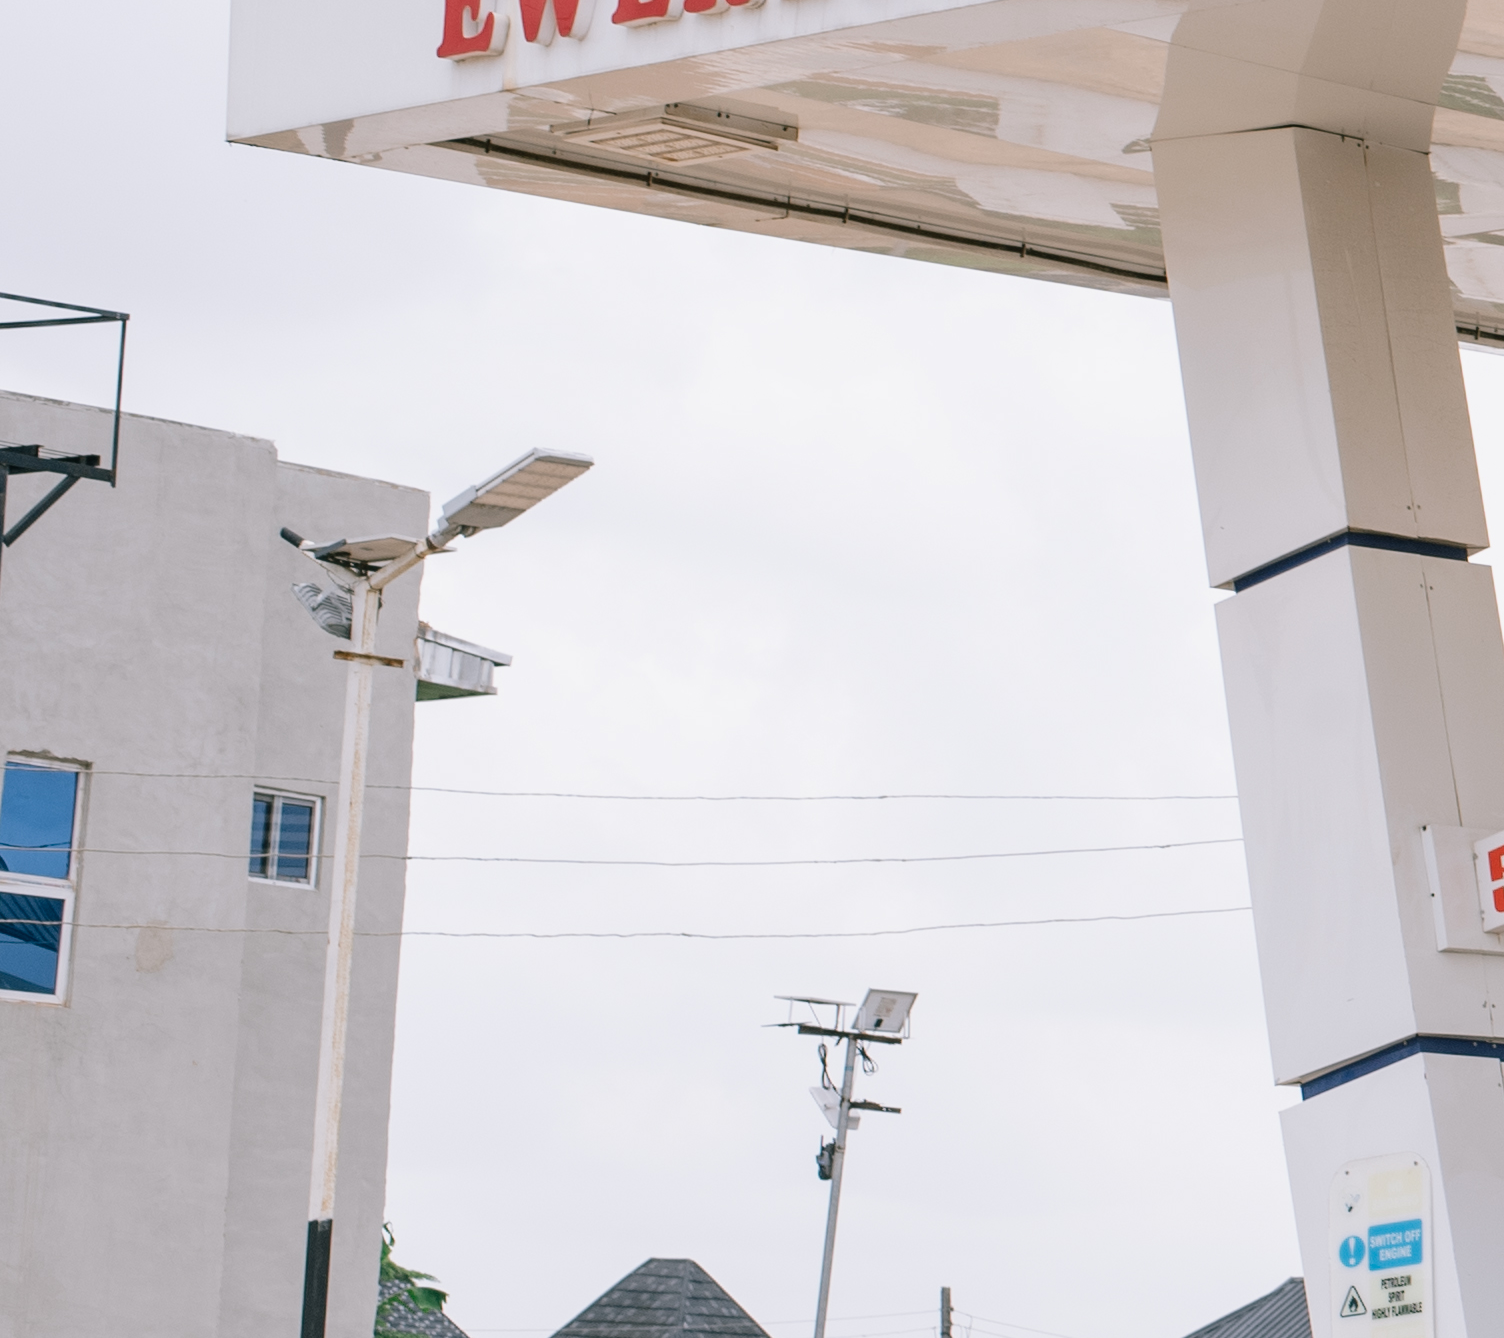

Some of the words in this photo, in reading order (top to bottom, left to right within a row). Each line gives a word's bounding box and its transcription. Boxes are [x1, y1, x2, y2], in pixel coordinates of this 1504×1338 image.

[1369, 1232, 1402, 1248] SWITCH
[1404, 1229, 1421, 1243] OFF
[1379, 1245, 1412, 1261] ENGINE
[1381, 1275, 1412, 1290] PETROLEUM
[1372, 1306, 1391, 1320] HIGHLY
[1392, 1301, 1423, 1318] FLAMMABLE
